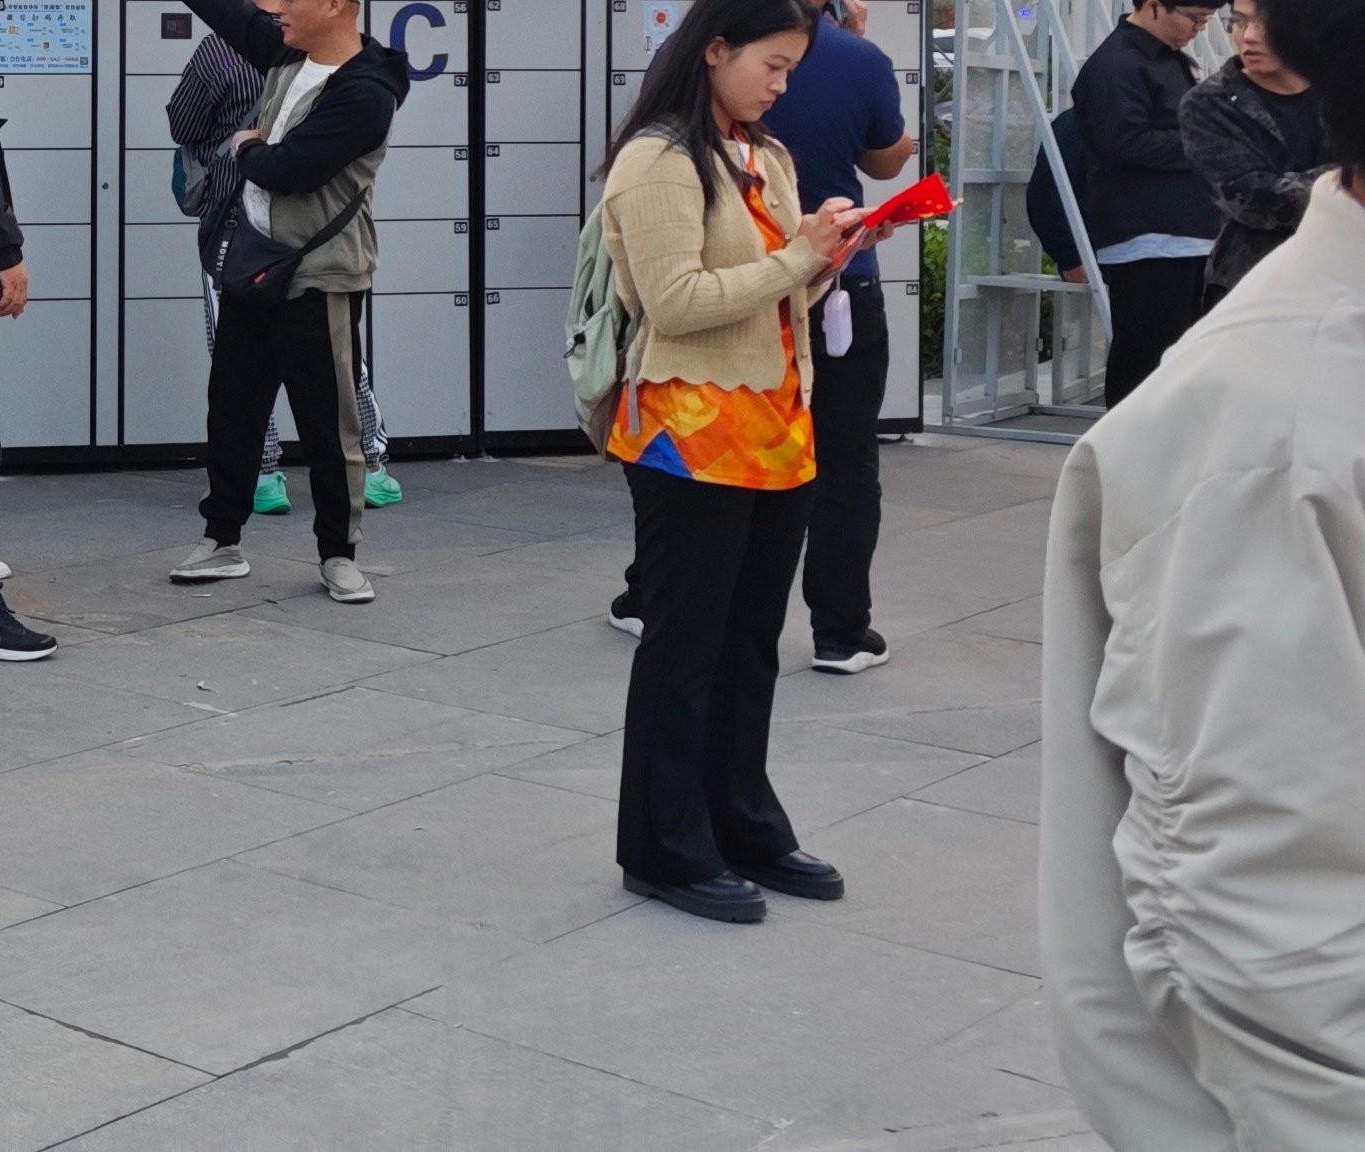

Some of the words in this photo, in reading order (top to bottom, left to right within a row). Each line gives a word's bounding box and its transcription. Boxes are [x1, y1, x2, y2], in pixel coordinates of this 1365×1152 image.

[454, 3, 467, 12] 56
[487, 0, 500, 10] 62
[389, 2, 449, 82] C
[455, 76, 467, 85] 57
[487, 72, 500, 82] 63
[455, 150, 467, 159] 58
[487, 146, 499, 156] 64
[455, 223, 467, 233] 59
[487, 219, 499, 229] 65
[455, 296, 467, 305] 60
[487, 293, 499, 304] 66
